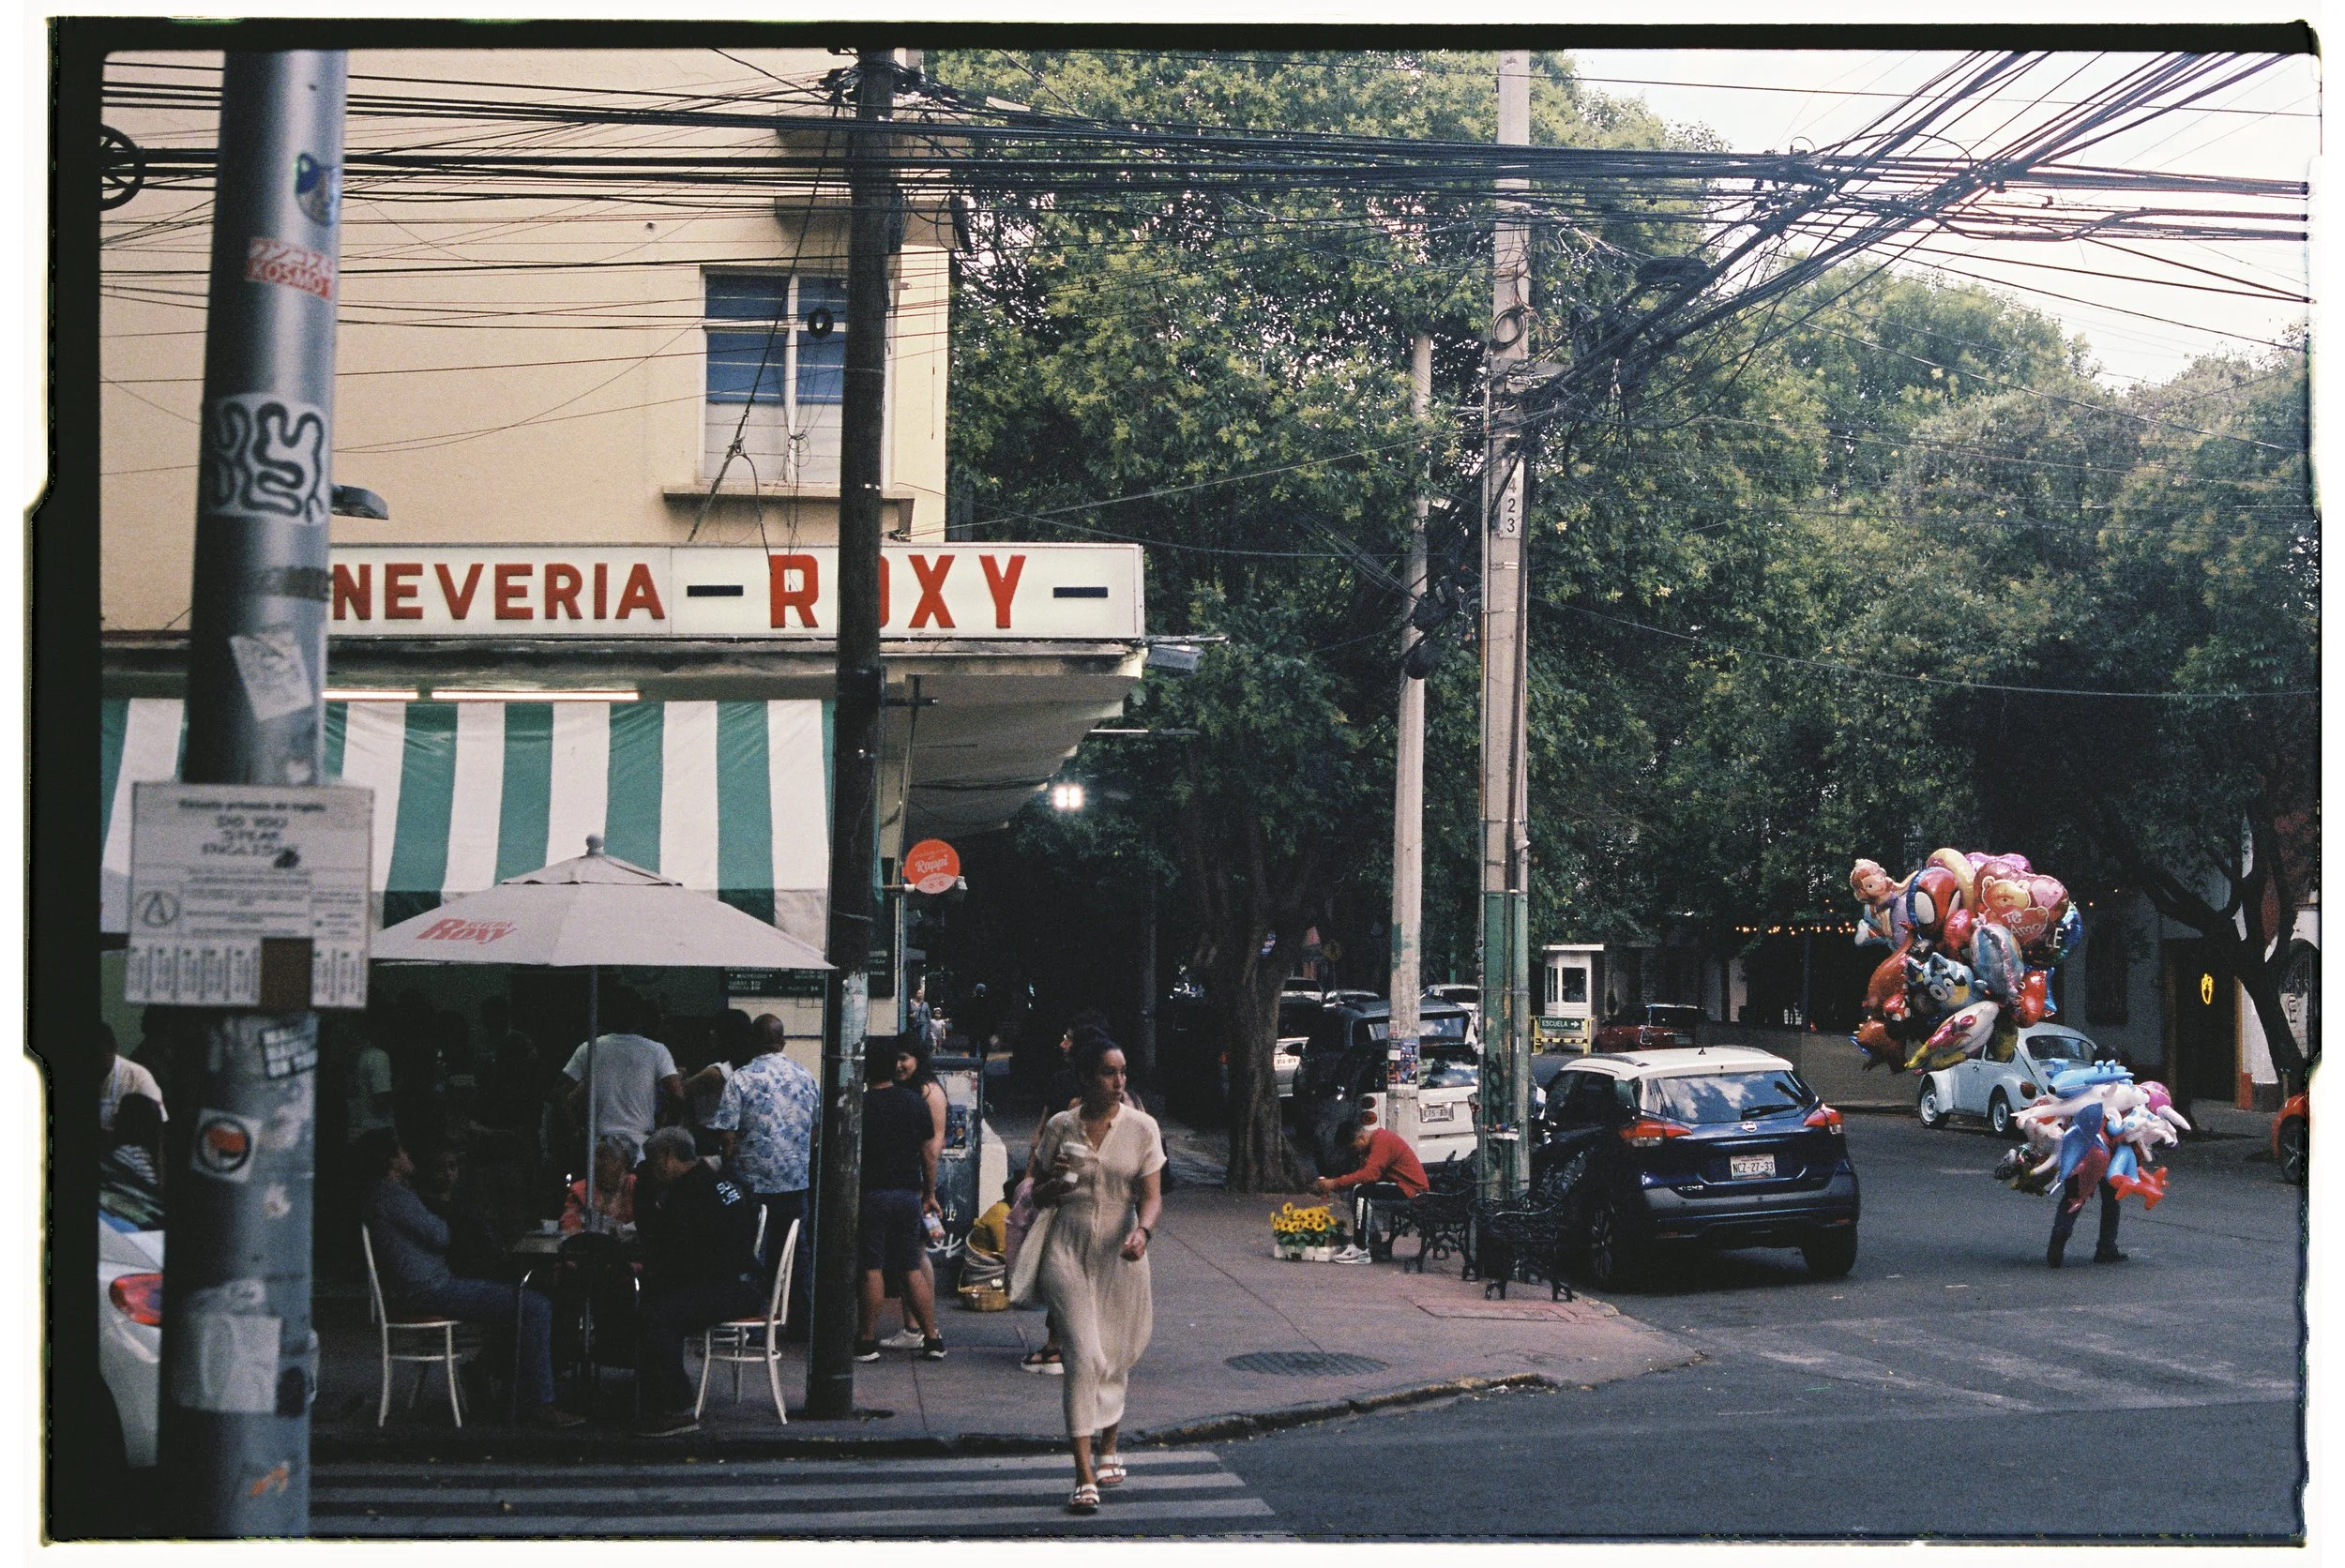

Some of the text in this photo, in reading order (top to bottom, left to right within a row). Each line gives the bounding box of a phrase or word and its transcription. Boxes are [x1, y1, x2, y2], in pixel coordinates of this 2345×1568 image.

[333, 553, 1027, 629] NEVERIA RXY
[1541, 1019, 1568, 1028] ESCUELA
